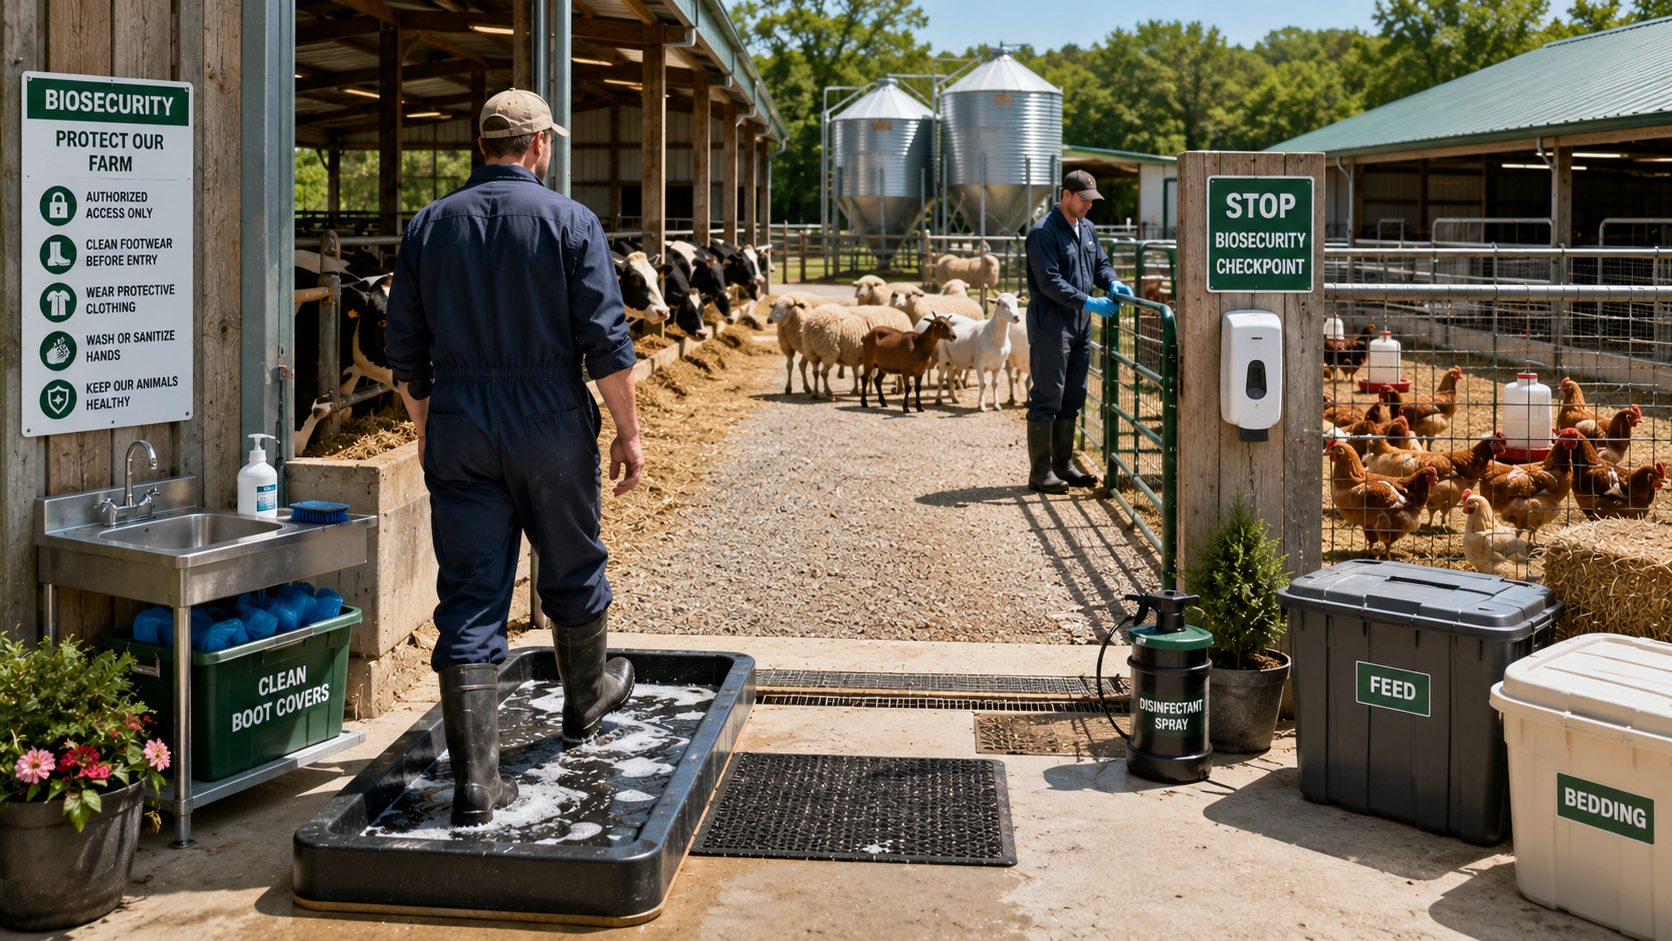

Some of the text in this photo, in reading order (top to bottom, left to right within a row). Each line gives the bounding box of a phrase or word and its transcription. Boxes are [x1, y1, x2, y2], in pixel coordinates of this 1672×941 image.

[45, 89, 174, 115] BIOSECURITY
[56, 130, 164, 149] PROTECT OUR
[89, 155, 132, 171] FARM
[86, 192, 148, 202] AUTHORIZED
[1226, 192, 1296, 218] STOP
[86, 207, 153, 218] ACCESS ONLY
[86, 238, 173, 250] CLEAN FOOTWEAR
[1215, 232, 1306, 248] BIOSECURITY
[86, 254, 158, 266] BEFORE ENTRY
[1216, 258, 1305, 274] CHECKPOINT
[86, 284, 175, 297] WEAR PROTECTIVE
[86, 302, 136, 314] CLOTHING
[86, 330, 175, 345] WASH OR SANITIZE
[86, 350, 121, 362] HANDS
[86, 376, 178, 393] KEEP OUR ANIMALS
[86, 396, 130, 410] HEALTHY
[258, 665, 306, 696] CLEAN
[1370, 676, 1417, 701] FEED
[232, 683, 330, 732] BOOT COVERS
[1139, 697, 1203, 715] DISINFECTANT
[1155, 717, 1189, 731] SPRAY
[1564, 787, 1647, 829] BEDDING
